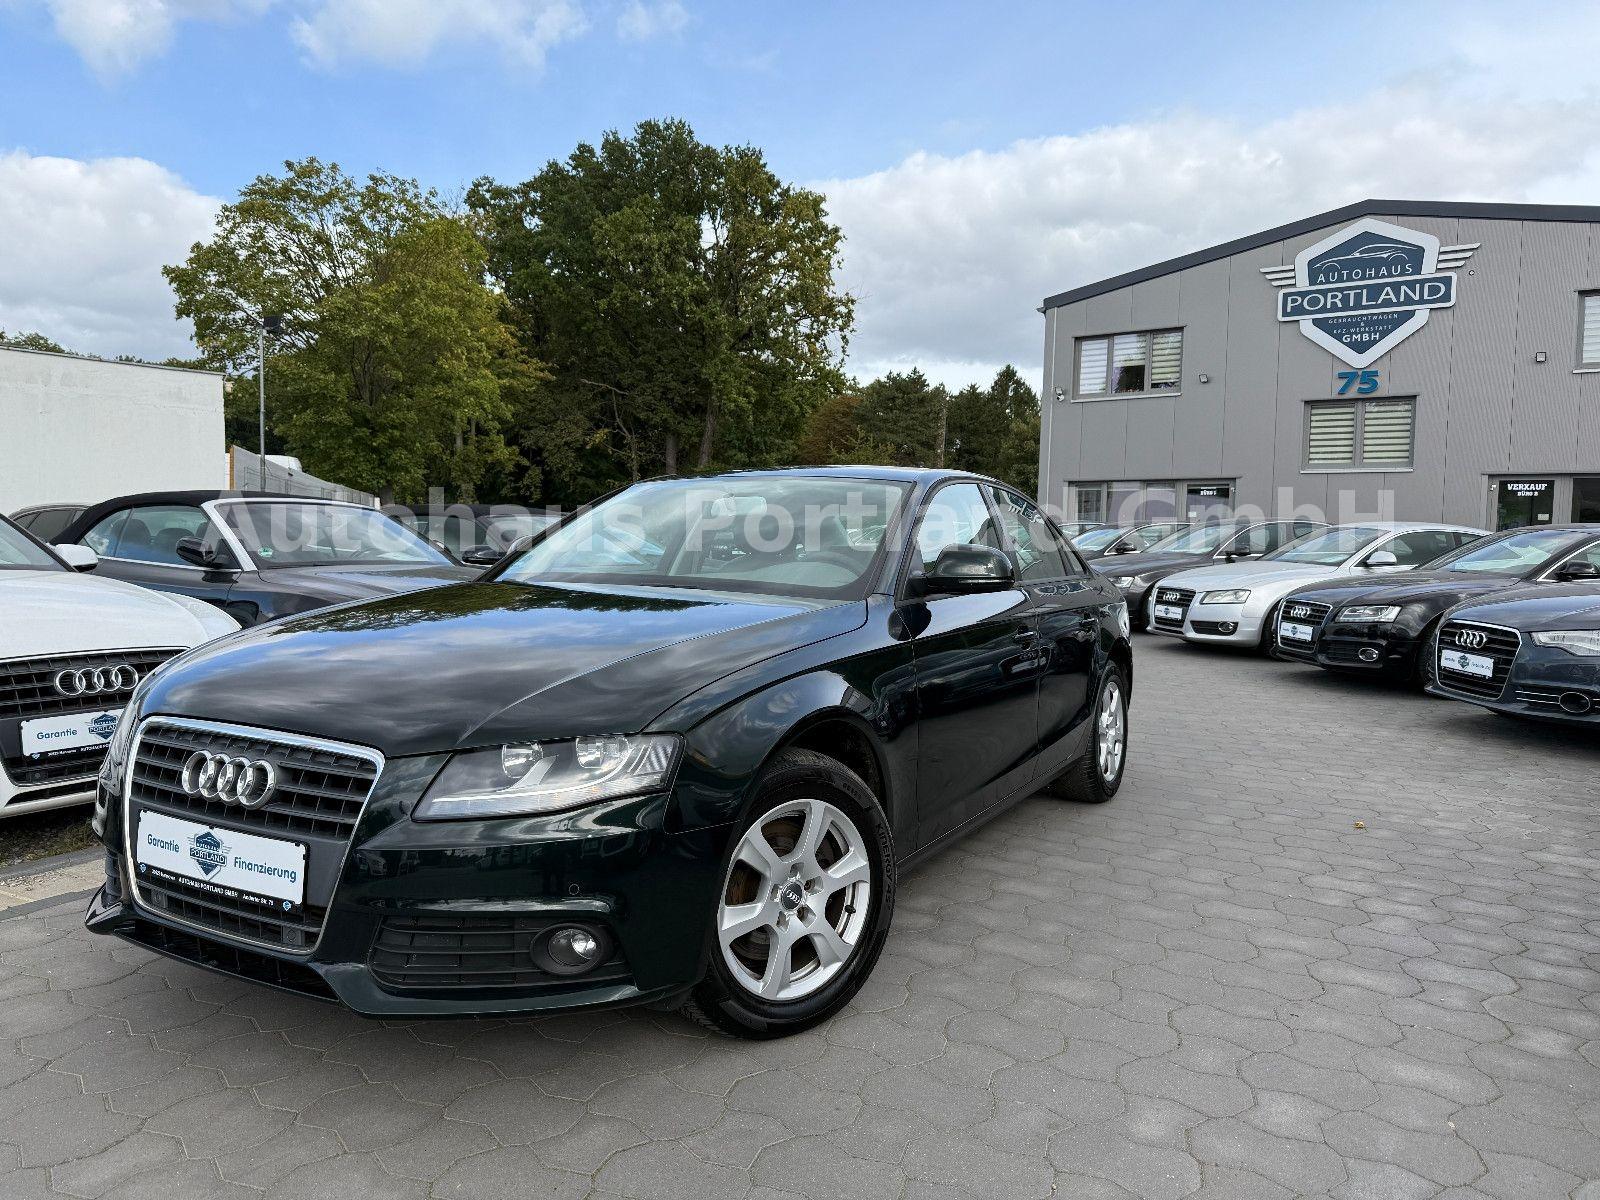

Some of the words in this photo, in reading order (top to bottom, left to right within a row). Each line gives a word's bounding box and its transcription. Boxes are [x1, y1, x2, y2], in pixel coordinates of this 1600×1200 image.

[1316, 263, 1413, 284] AUTOHAUS
[1286, 282, 1446, 313] PORTLAND
[1328, 313, 1399, 324] GEBRAUCHTWAGEN
[1342, 333, 1380, 343] GMBH
[1337, 370, 1379, 395] 75
[36, 728, 78, 740] Garantie
[90, 724, 117, 733] PORTLAN
[147, 834, 180, 853] Garantie
[190, 847, 225, 863] PORTLAND
[234, 856, 297, 883] Finanzierung
